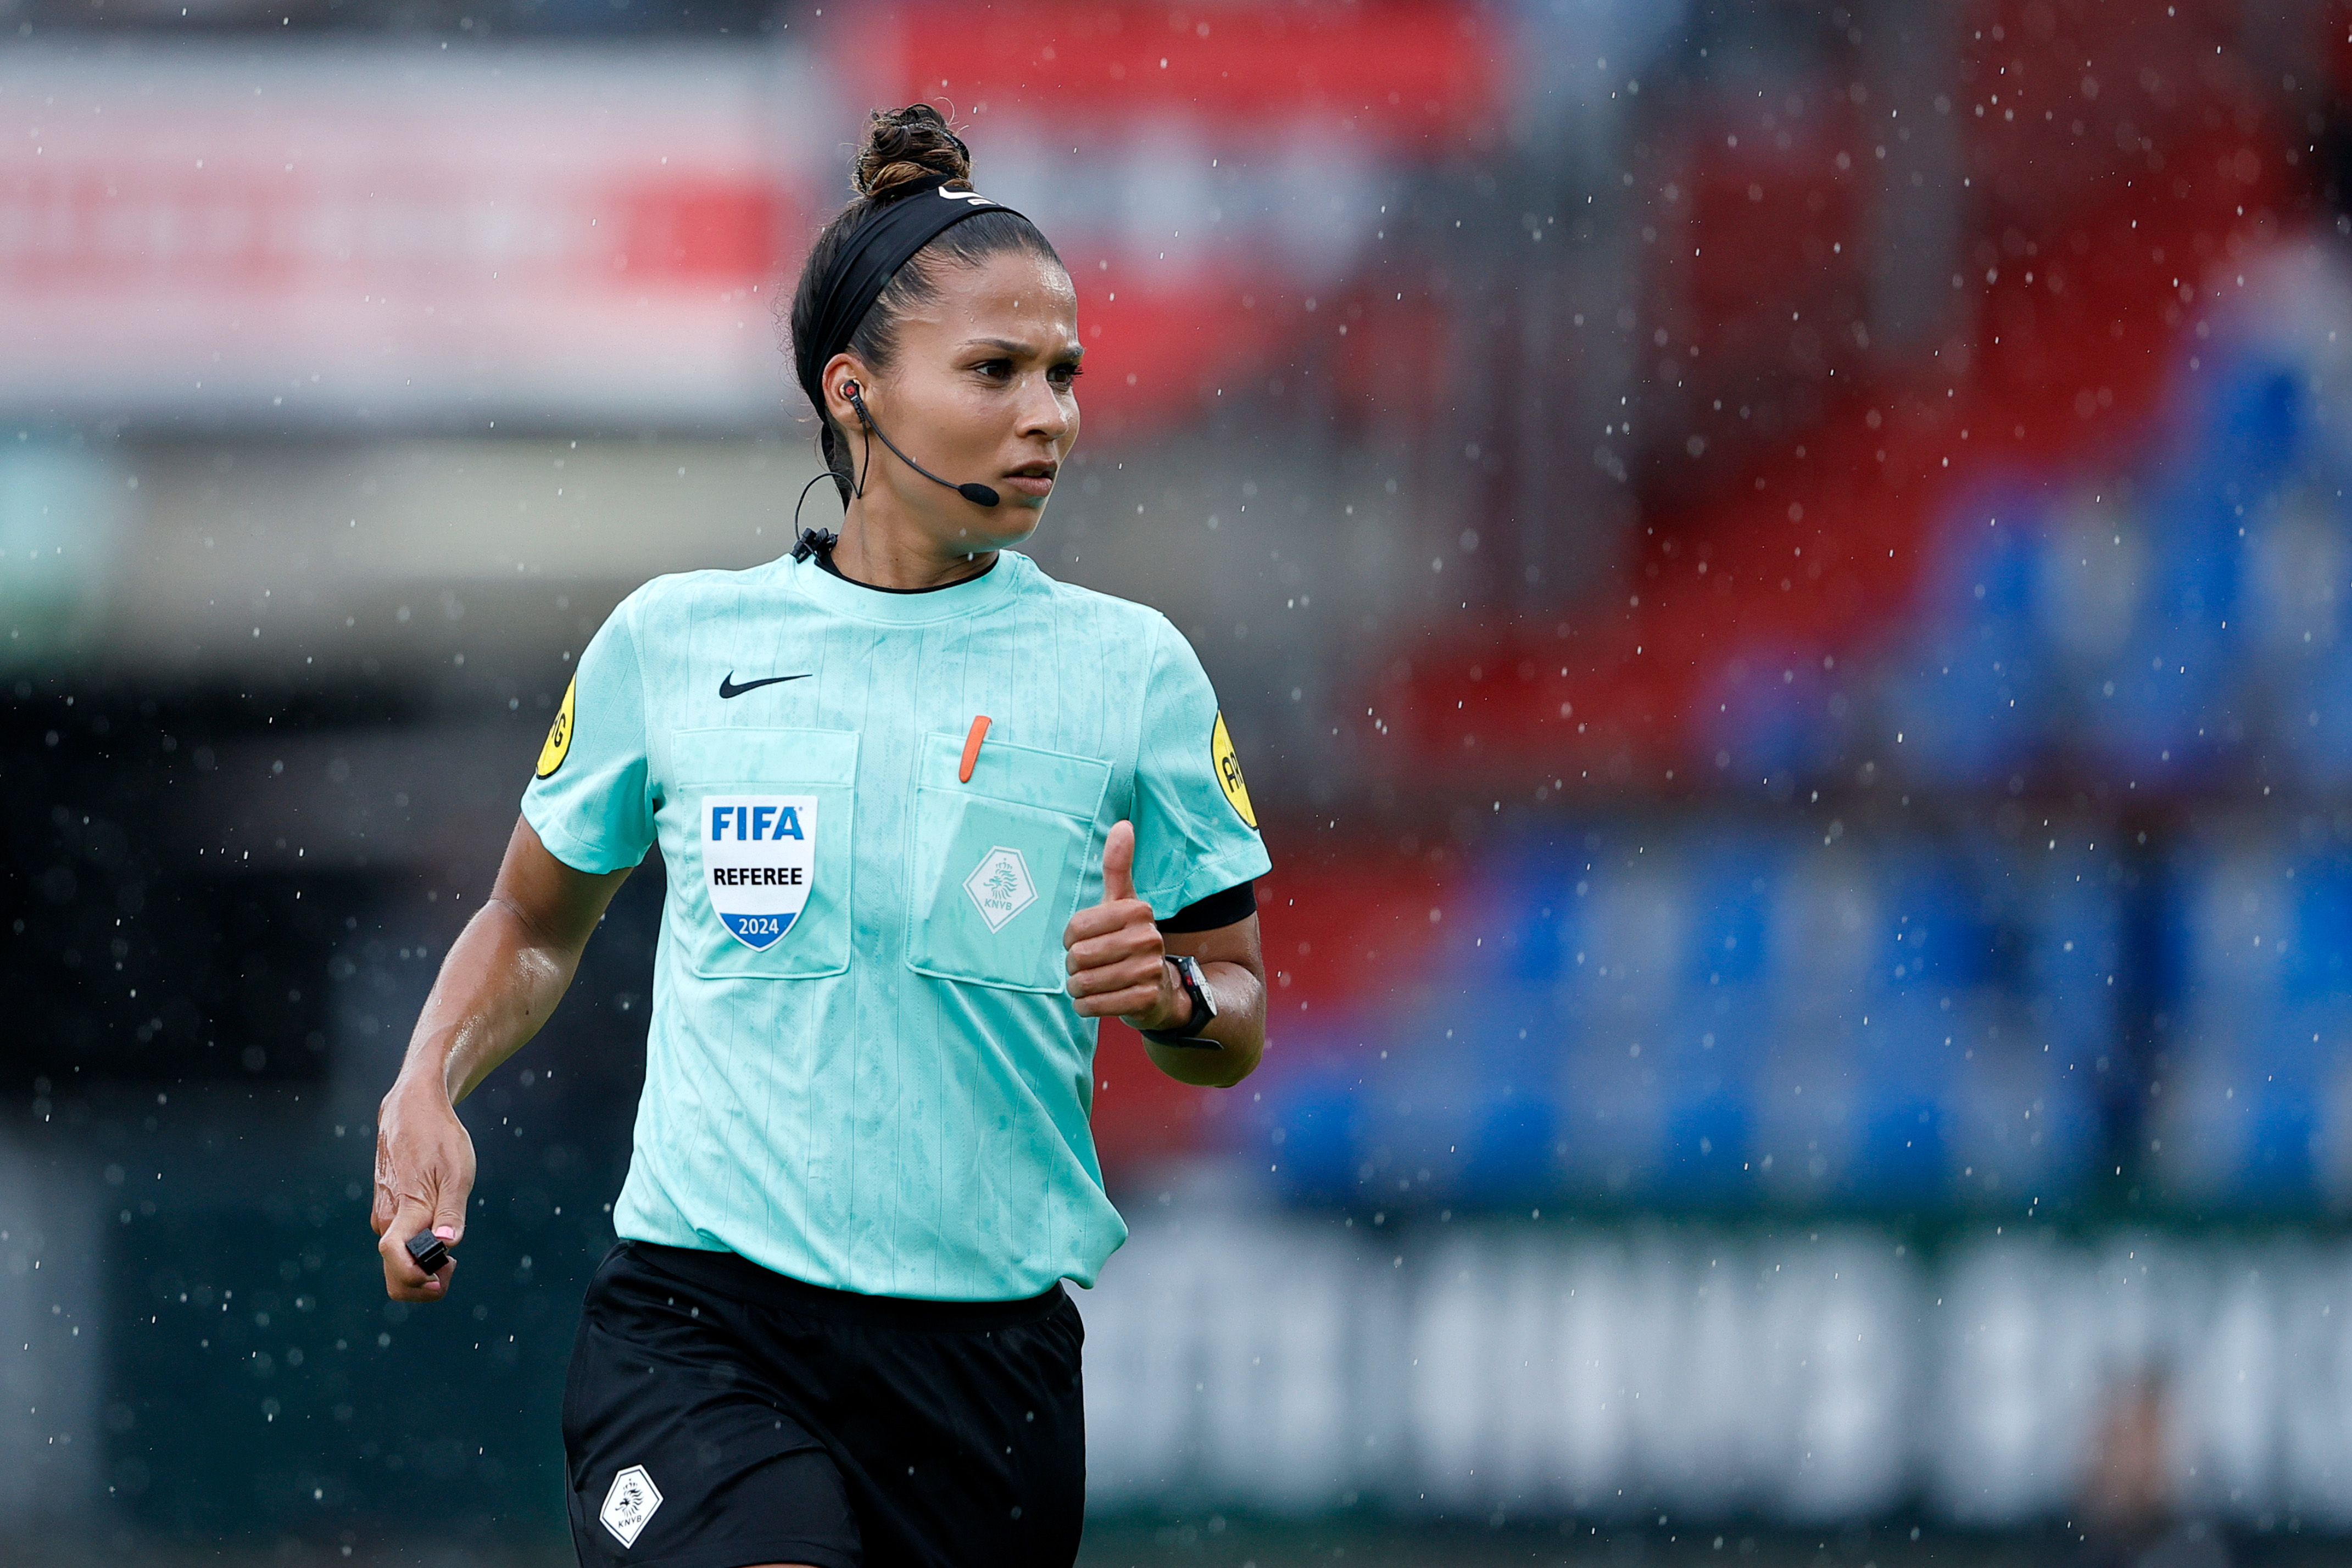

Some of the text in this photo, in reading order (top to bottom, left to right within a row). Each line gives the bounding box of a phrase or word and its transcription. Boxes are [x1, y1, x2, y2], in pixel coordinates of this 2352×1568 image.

[712, 806, 804, 840] FIFA
[714, 868, 802, 885] REFEREE
[984, 898, 1012, 911] KNVB
[739, 918, 779, 934] 2024
[618, 1515, 642, 1528] KNVB
